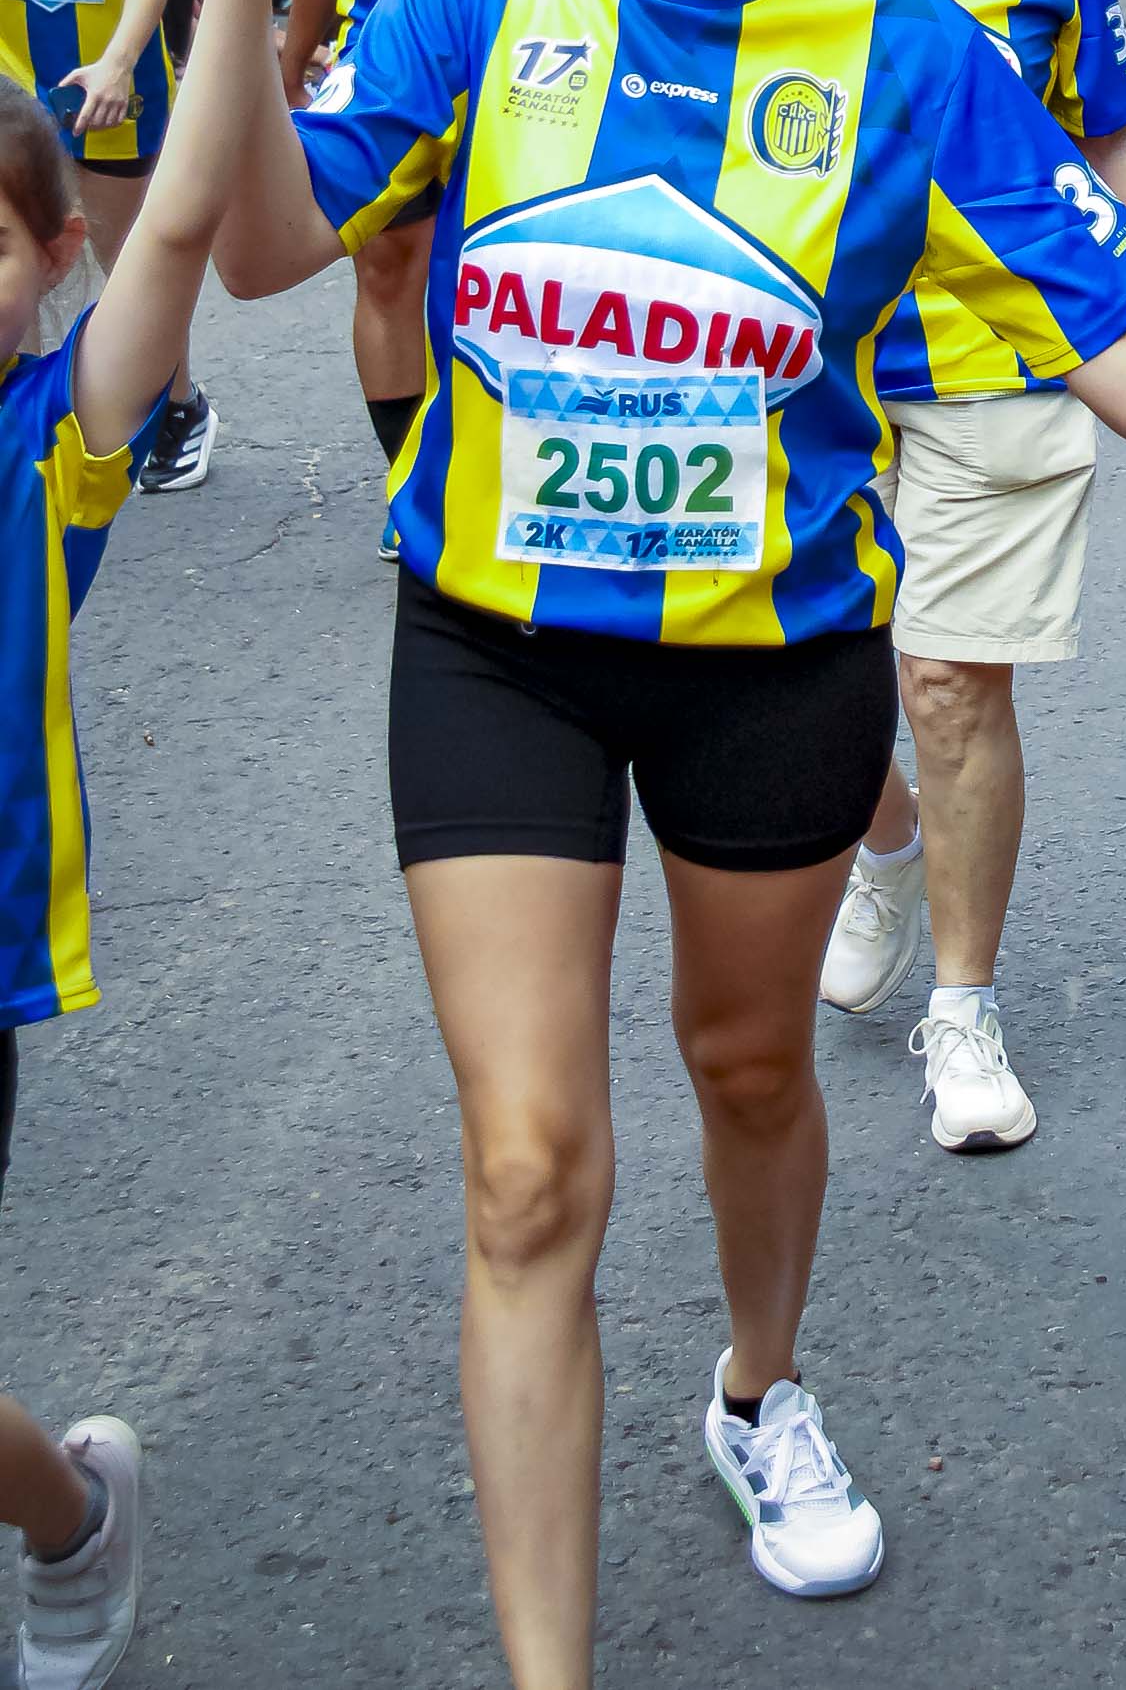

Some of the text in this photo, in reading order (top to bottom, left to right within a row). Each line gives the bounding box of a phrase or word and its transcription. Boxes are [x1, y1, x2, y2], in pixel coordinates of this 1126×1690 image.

[516, 38, 593, 86] 17
[509, 85, 580, 107] MARATÓN
[649, 79, 720, 105] express
[507, 96, 577, 118] CANALLA
[1053, 160, 1125, 247] 3
[454, 263, 815, 379] PALADINI
[535, 436, 735, 515] 2502
[524, 521, 568, 550] 2K
[674, 525, 741, 539] MARATÓN
[674, 538, 739, 549] CANALLA
